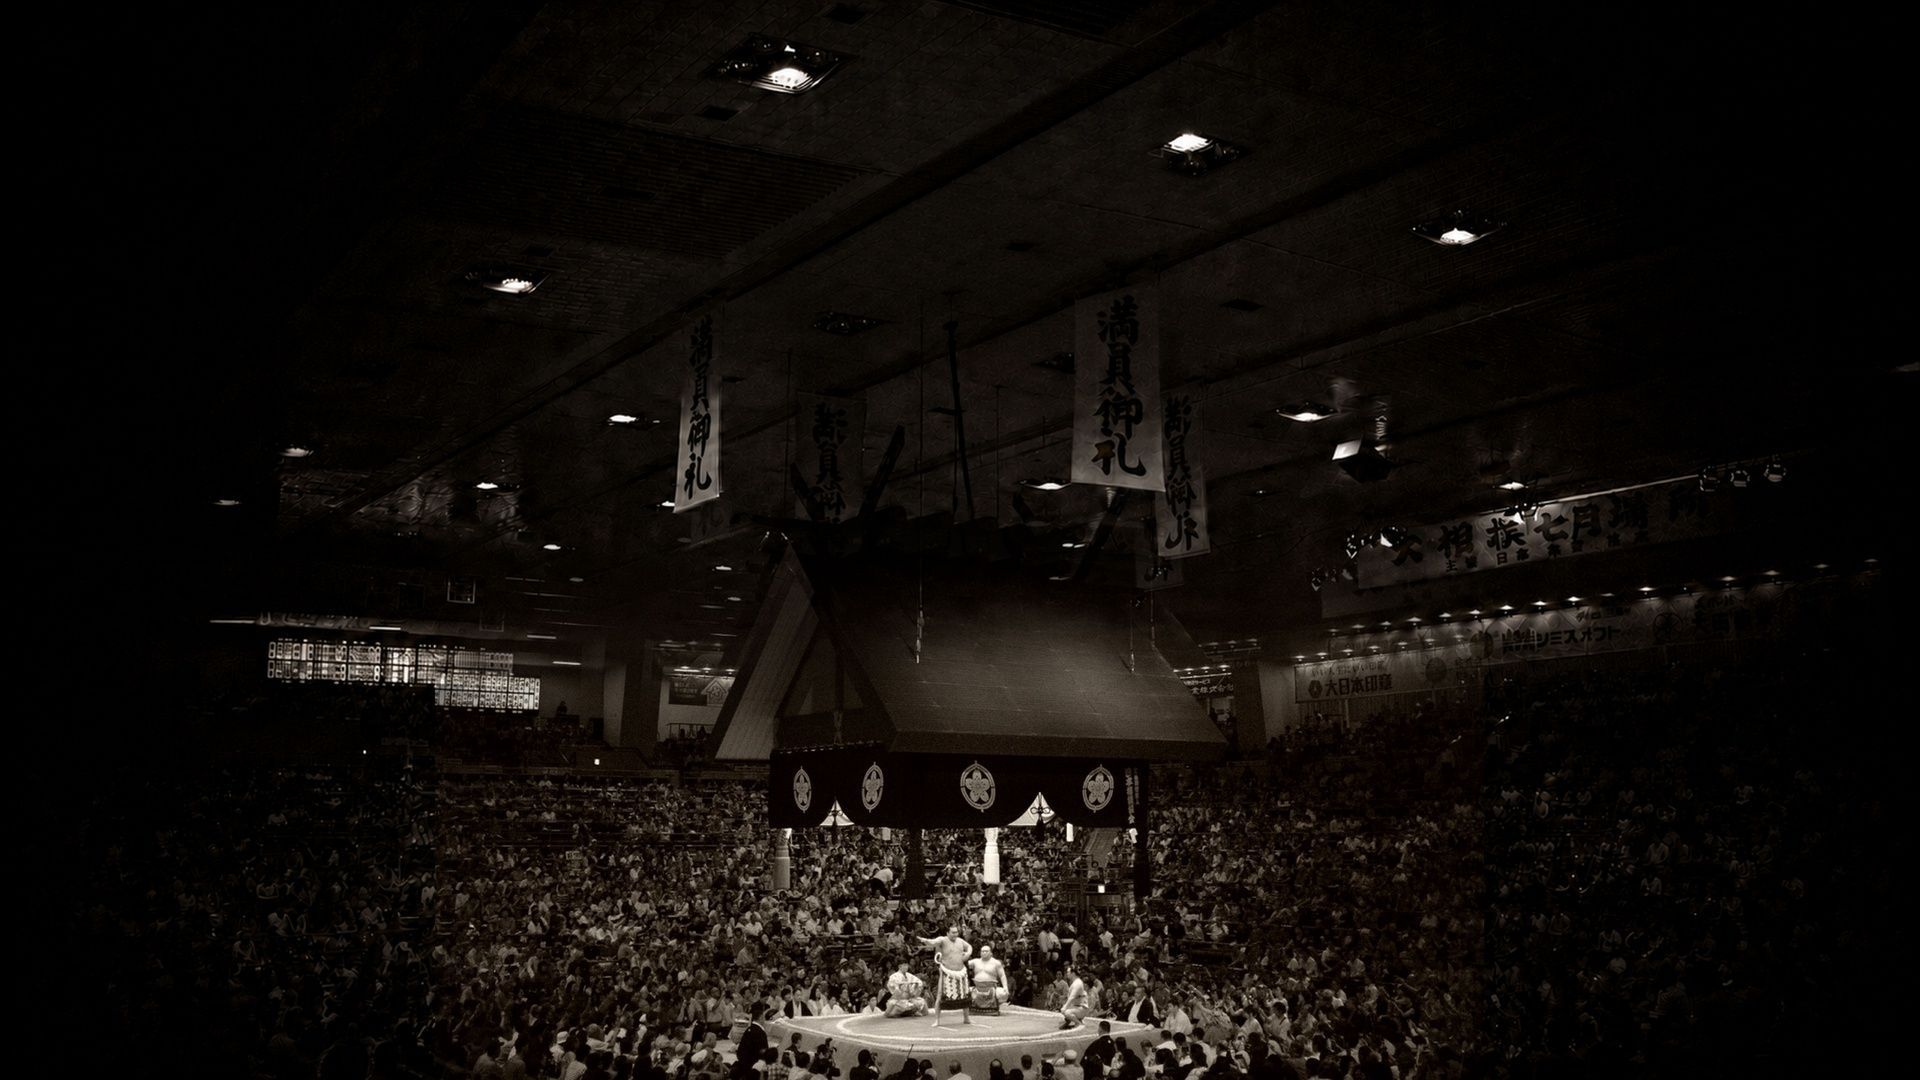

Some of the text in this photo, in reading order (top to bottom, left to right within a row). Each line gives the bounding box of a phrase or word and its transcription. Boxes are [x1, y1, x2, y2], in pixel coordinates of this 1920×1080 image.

[685, 314, 714, 499] 満員御礼
[1092, 294, 1146, 476] 満員御礼
